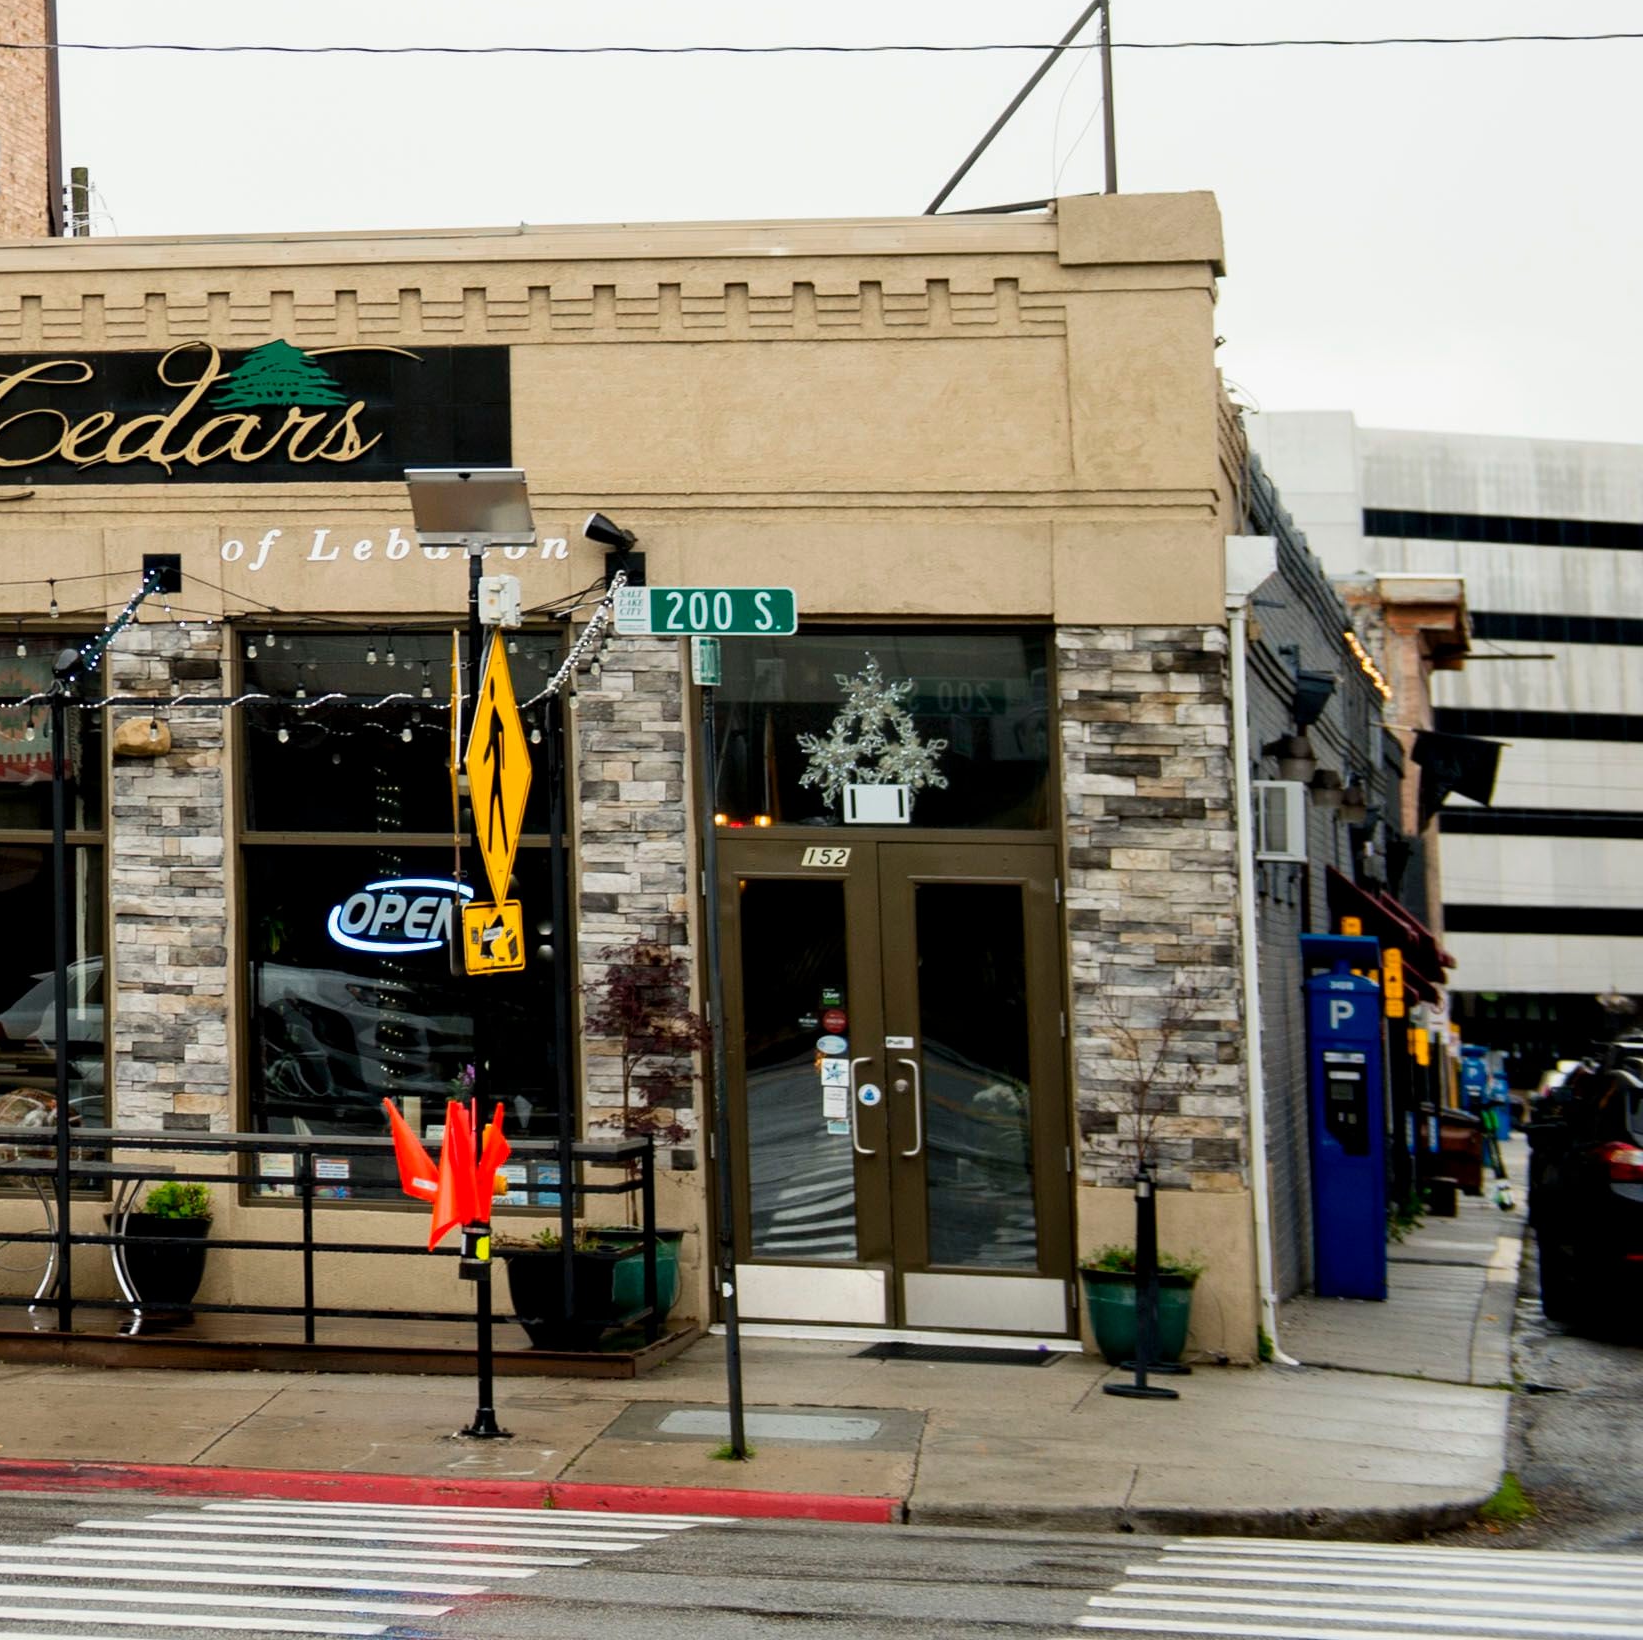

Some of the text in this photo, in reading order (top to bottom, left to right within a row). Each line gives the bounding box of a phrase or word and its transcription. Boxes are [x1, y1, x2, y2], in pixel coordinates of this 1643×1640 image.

[221, 528, 282, 571] of
[619, 590, 643, 598] SALT
[619, 599, 643, 607] LAKE
[619, 607, 643, 616] CITY
[665, 591, 734, 631] 200
[807, 848, 847, 866] 152
[1329, 999, 1355, 1030] P
